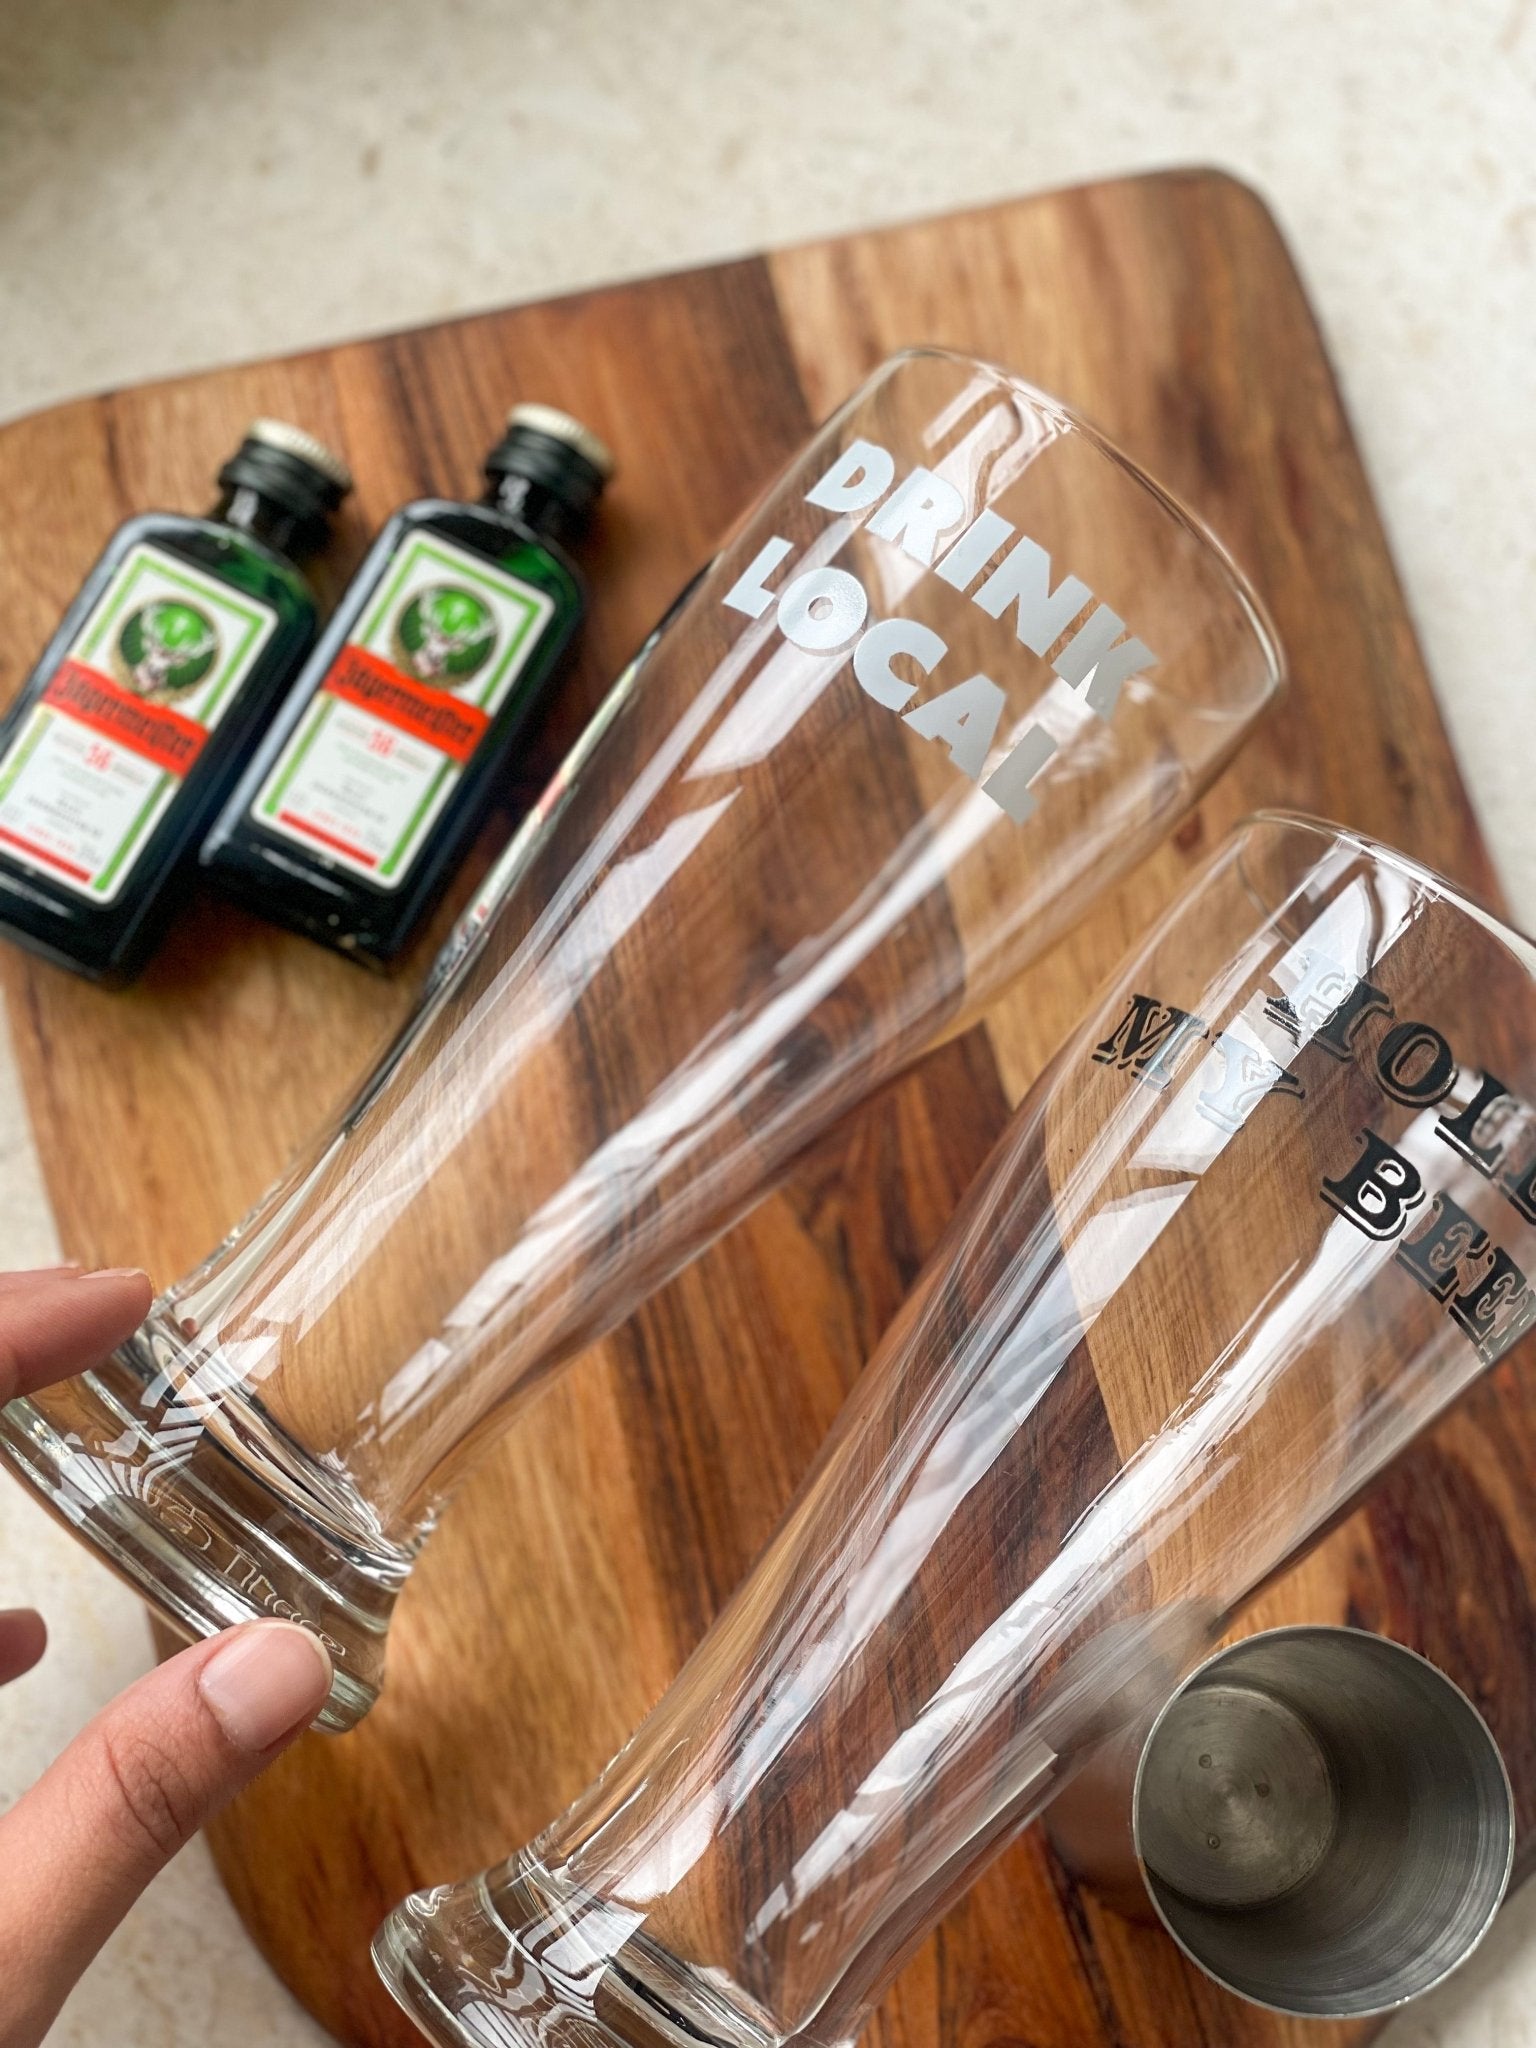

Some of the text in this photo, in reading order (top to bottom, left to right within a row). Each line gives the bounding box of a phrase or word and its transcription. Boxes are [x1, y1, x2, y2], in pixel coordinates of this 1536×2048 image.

[721, 535, 1059, 826] LOCAL
[804, 438, 1161, 723] DRINK
[1091, 993, 1307, 1134] MY
